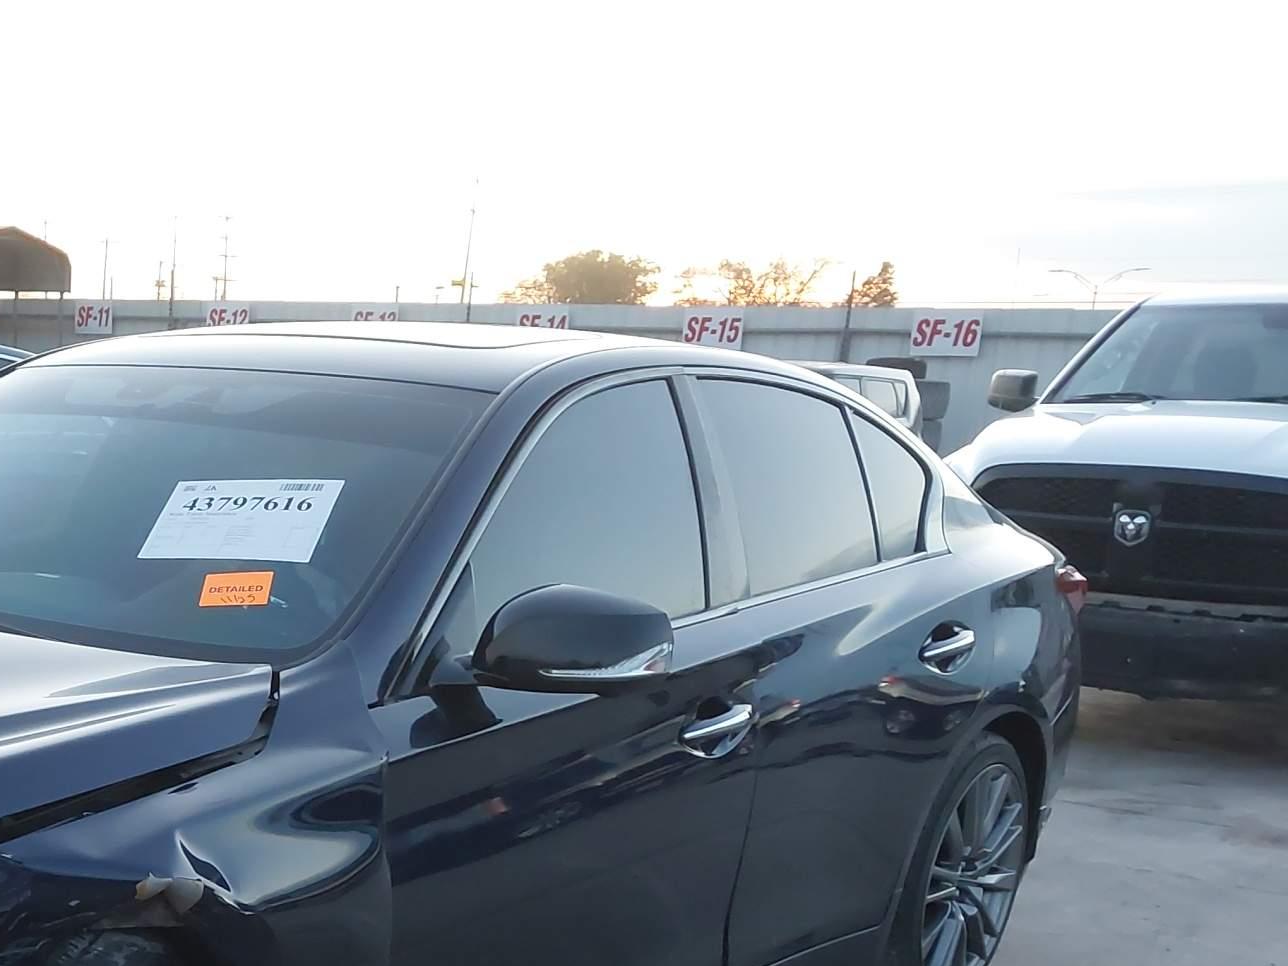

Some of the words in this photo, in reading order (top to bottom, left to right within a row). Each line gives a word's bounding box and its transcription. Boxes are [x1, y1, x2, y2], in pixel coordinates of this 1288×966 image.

[77, 305, 110, 328] SF-11
[207, 308, 248, 326] SF-12
[519, 314, 568, 329] SF14
[685, 316, 743, 343] SF-15
[912, 319, 981, 347] SF-16
[182, 496, 316, 512] 43797616
[208, 584, 264, 594] DETAILED
